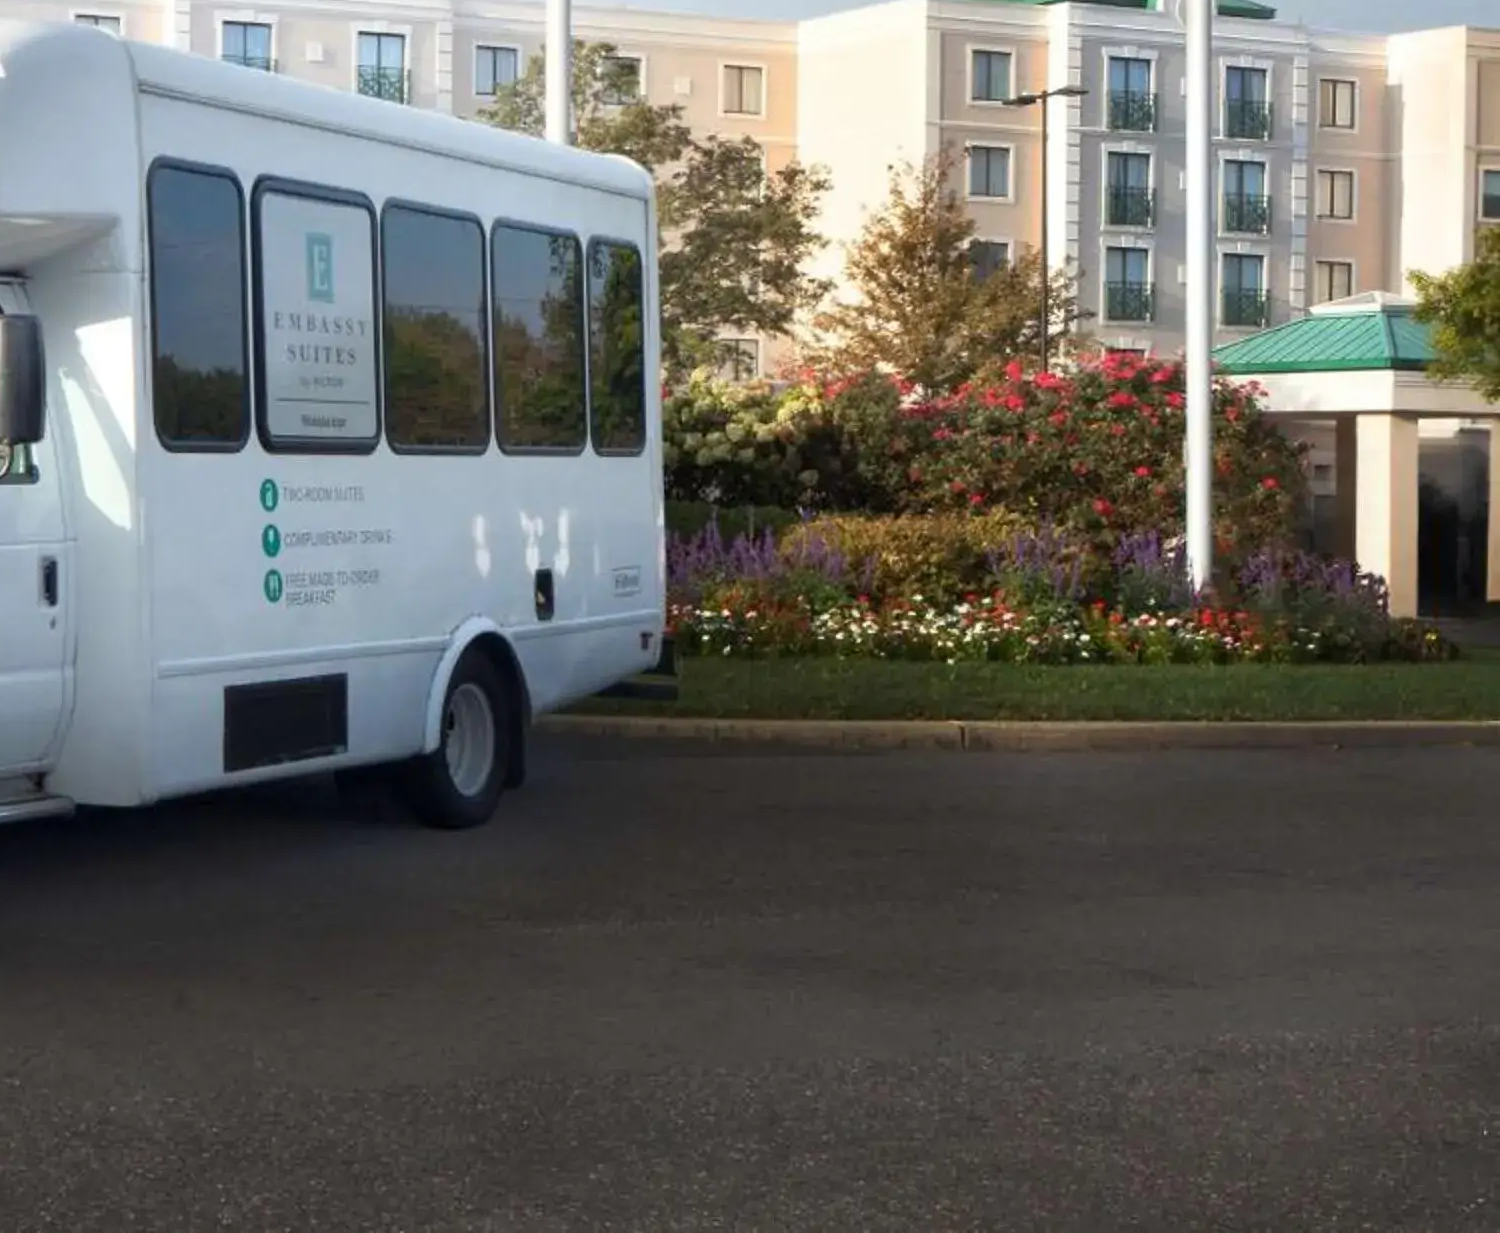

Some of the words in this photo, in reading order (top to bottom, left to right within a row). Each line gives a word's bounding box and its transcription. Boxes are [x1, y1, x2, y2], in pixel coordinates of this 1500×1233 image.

[312, 243, 329, 291] E
[274, 311, 368, 337] EMBASSY
[286, 342, 357, 366] SUITES
